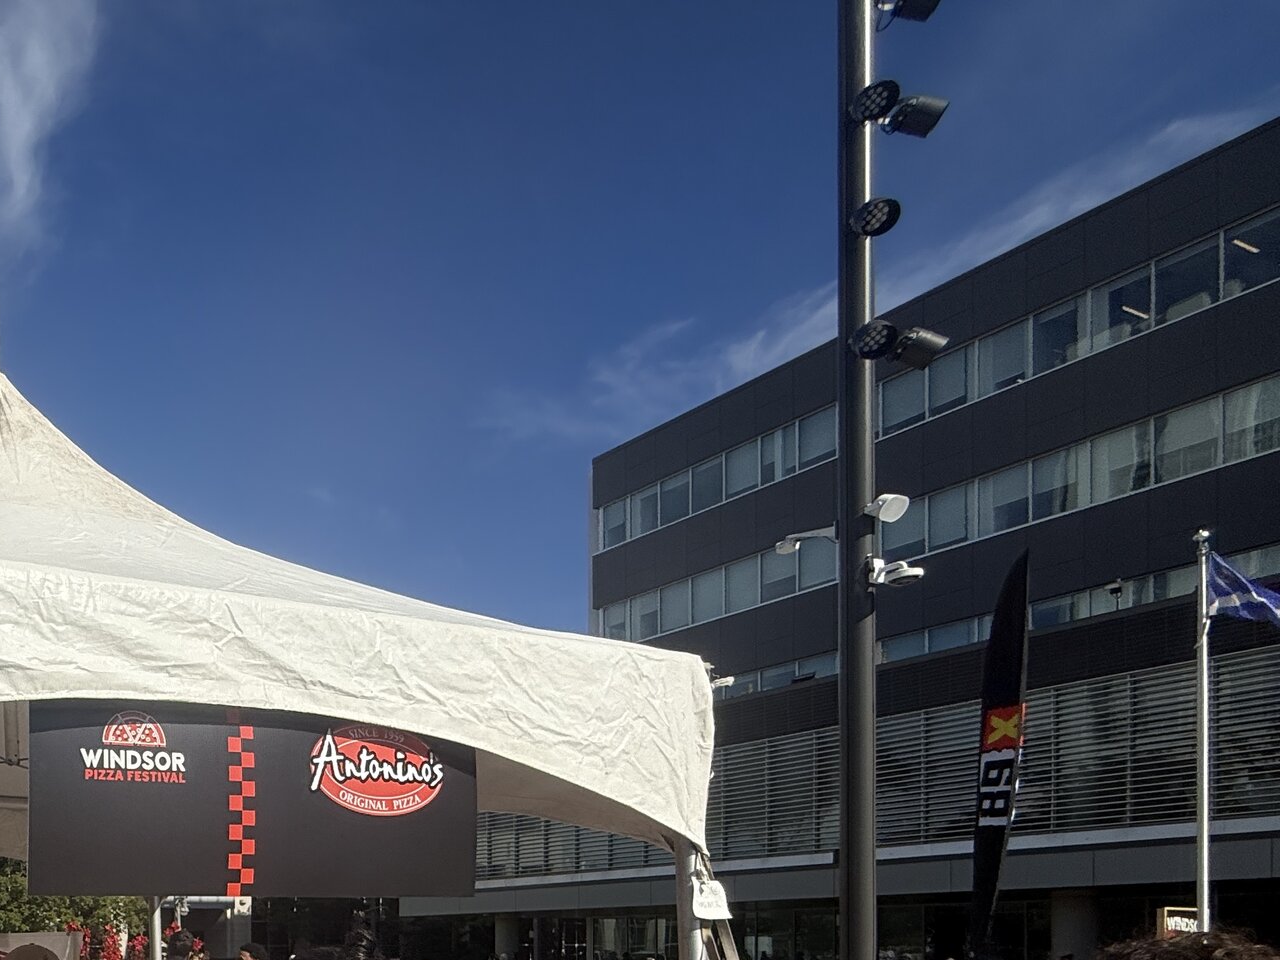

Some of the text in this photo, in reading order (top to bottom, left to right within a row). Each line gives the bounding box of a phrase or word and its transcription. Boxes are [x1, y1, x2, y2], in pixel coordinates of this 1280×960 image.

[348, 728, 379, 740] SINCE
[80, 748, 186, 772] WINDSOR
[310, 728, 444, 791] Antonino's
[84, 769, 186, 784] PIZZA FESTIVAL
[339, 790, 422, 811] ORIGINAL PIZZA
